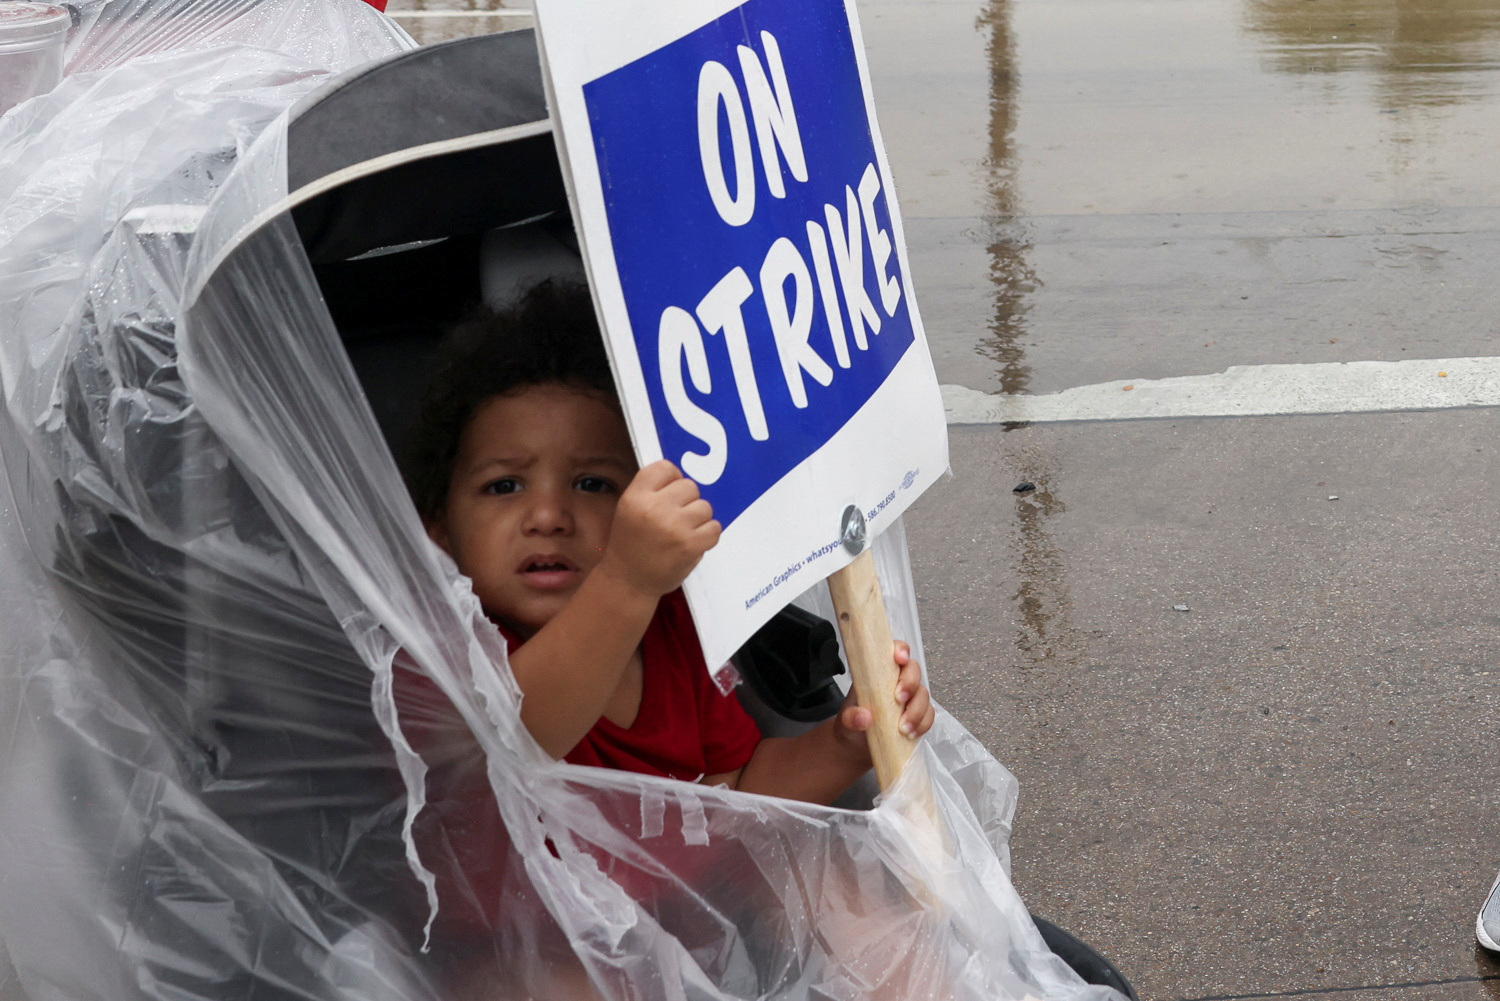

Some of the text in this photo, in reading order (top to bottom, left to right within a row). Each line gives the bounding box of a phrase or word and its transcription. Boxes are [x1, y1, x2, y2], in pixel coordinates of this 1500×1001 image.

[697, 29, 809, 227] ON
[658, 162, 901, 486] STRIKE
[745, 583, 773, 611] American
[773, 562, 802, 587] Graphics
